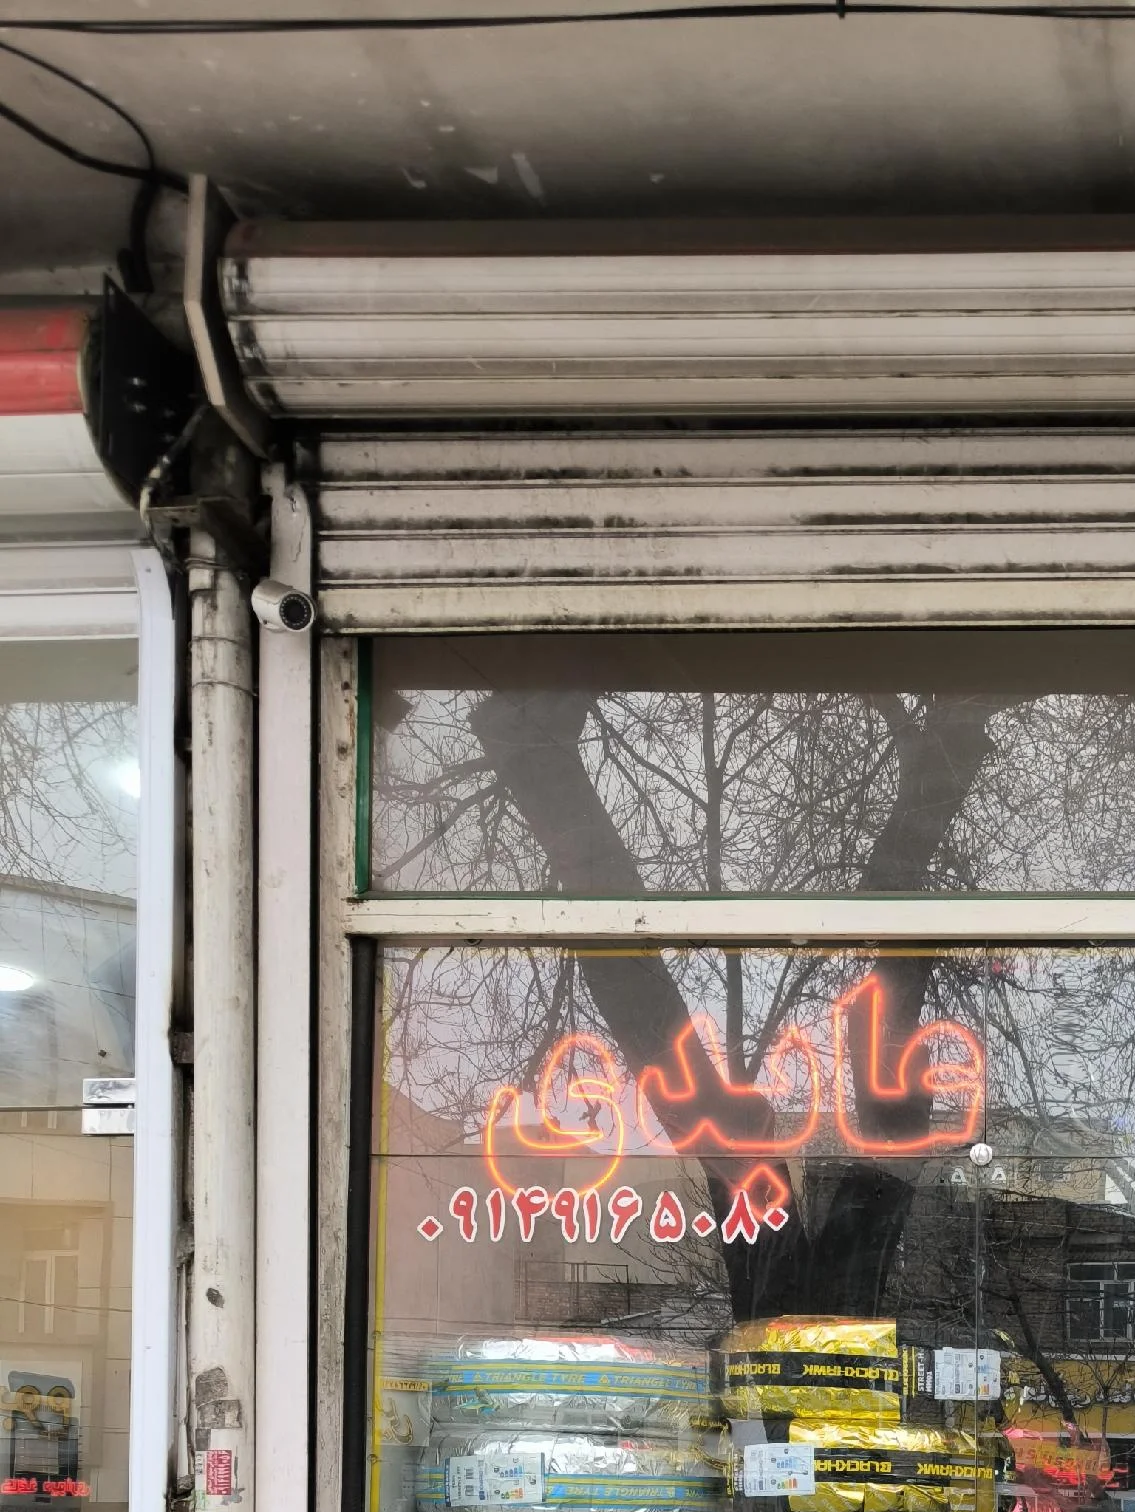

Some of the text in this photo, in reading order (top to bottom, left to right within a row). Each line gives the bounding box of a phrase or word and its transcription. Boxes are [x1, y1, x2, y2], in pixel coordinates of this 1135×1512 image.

[416, 1184, 790, 1244] ۰۹۱۴۹۱۶۵۰۸۰
[486, 1372, 586, 1384] TRIANGLE TYRE
[802, 1362, 899, 1383] BLACKHAWK
[814, 1459, 892, 1473] BLACKHA
